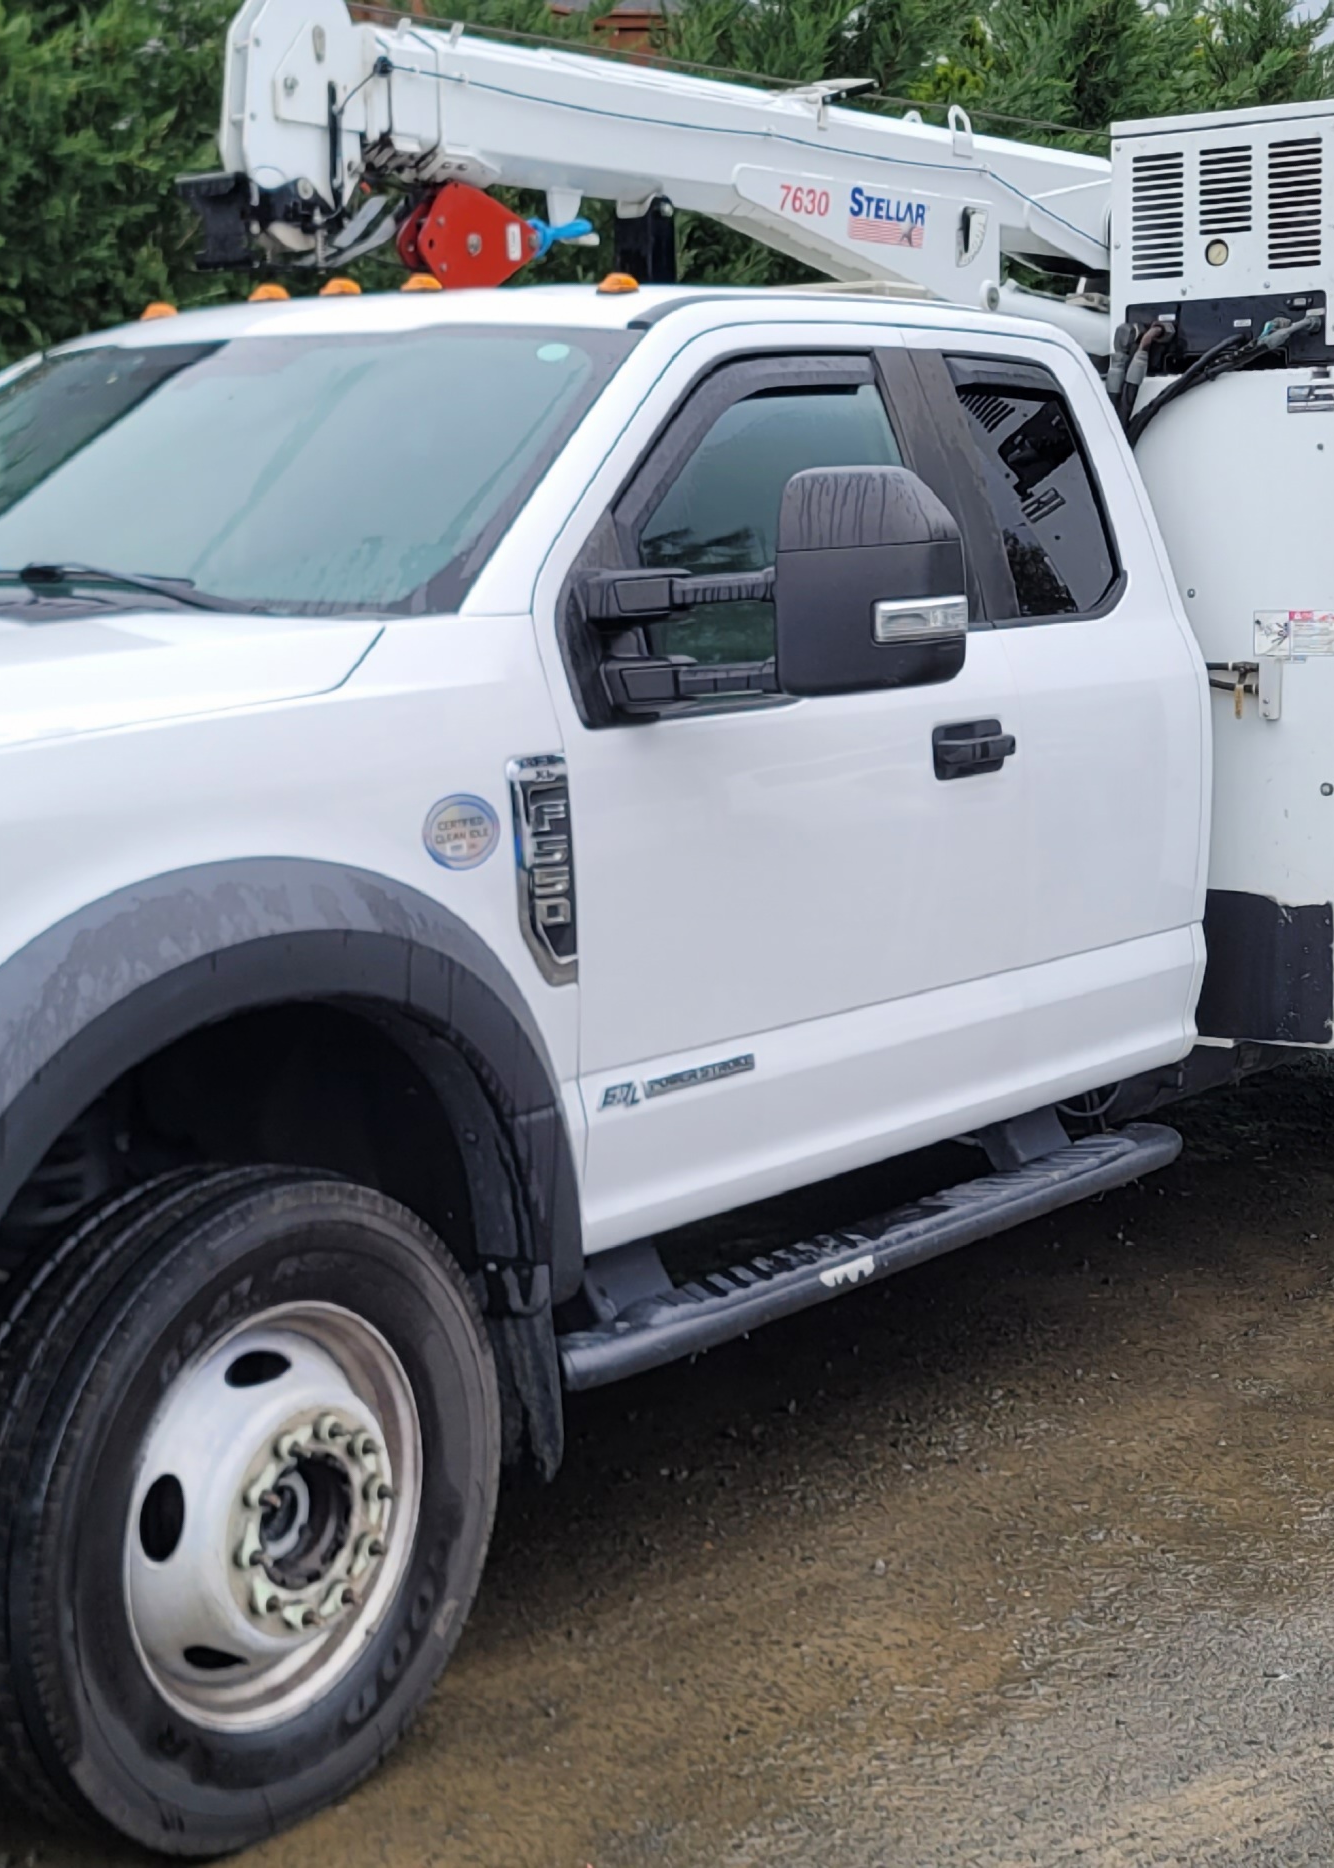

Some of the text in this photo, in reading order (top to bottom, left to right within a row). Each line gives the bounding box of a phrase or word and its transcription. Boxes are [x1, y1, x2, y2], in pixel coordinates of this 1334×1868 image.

[780, 184, 830, 217] 7630
[849, 186, 926, 226] STELLAR
[434, 832, 467, 845] CLEAN
